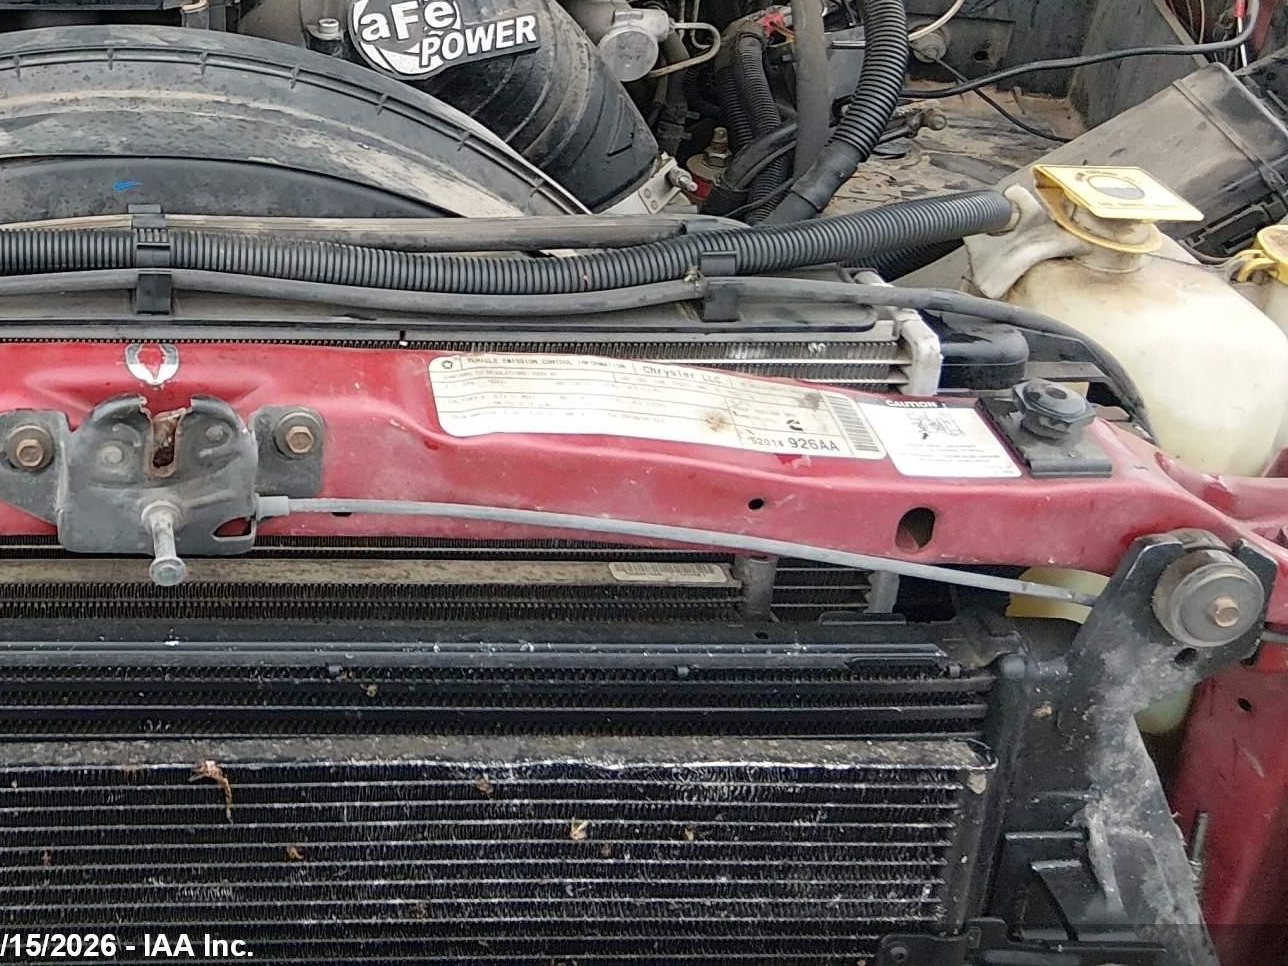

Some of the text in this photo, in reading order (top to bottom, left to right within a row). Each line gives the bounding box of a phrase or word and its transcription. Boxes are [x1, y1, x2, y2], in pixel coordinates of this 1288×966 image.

[359, 0, 457, 42] aFe
[420, 14, 538, 67] POWER
[642, 365, 722, 384] Chrysler LLC
[885, 399, 938, 409] CAUTION
[787, 436, 841, 452] 926AA
